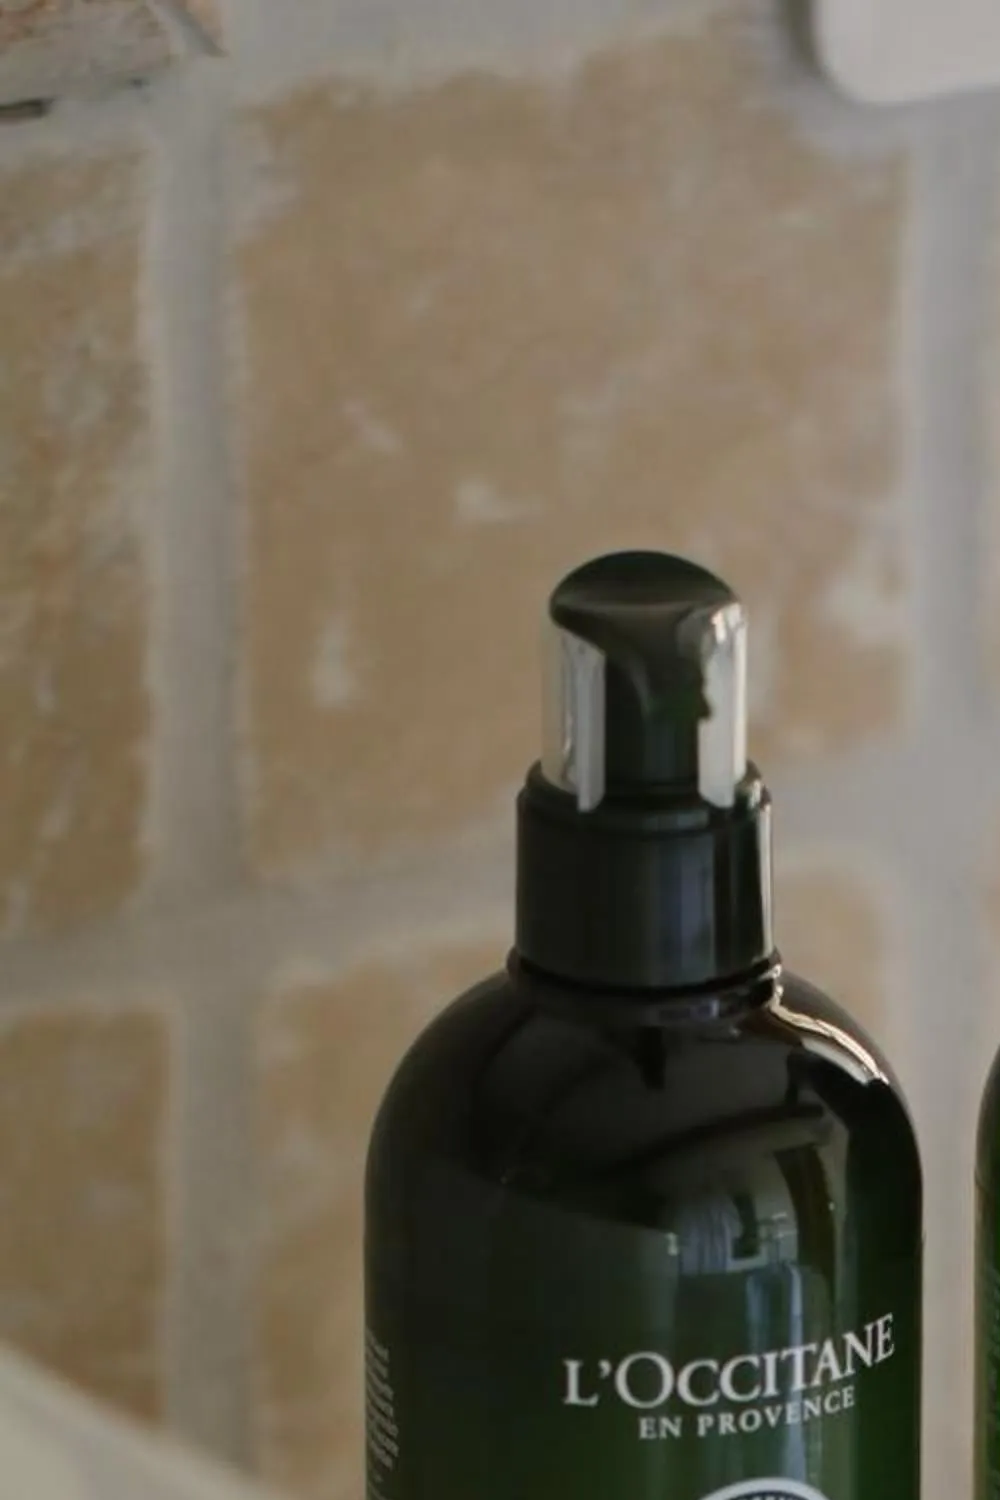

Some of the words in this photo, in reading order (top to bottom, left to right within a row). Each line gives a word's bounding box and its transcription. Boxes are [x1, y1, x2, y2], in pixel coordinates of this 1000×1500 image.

[563, 1312, 896, 1409] L'OCCITANE
[638, 1416, 683, 1440] EN
[697, 1385, 857, 1439] PROVENCE
